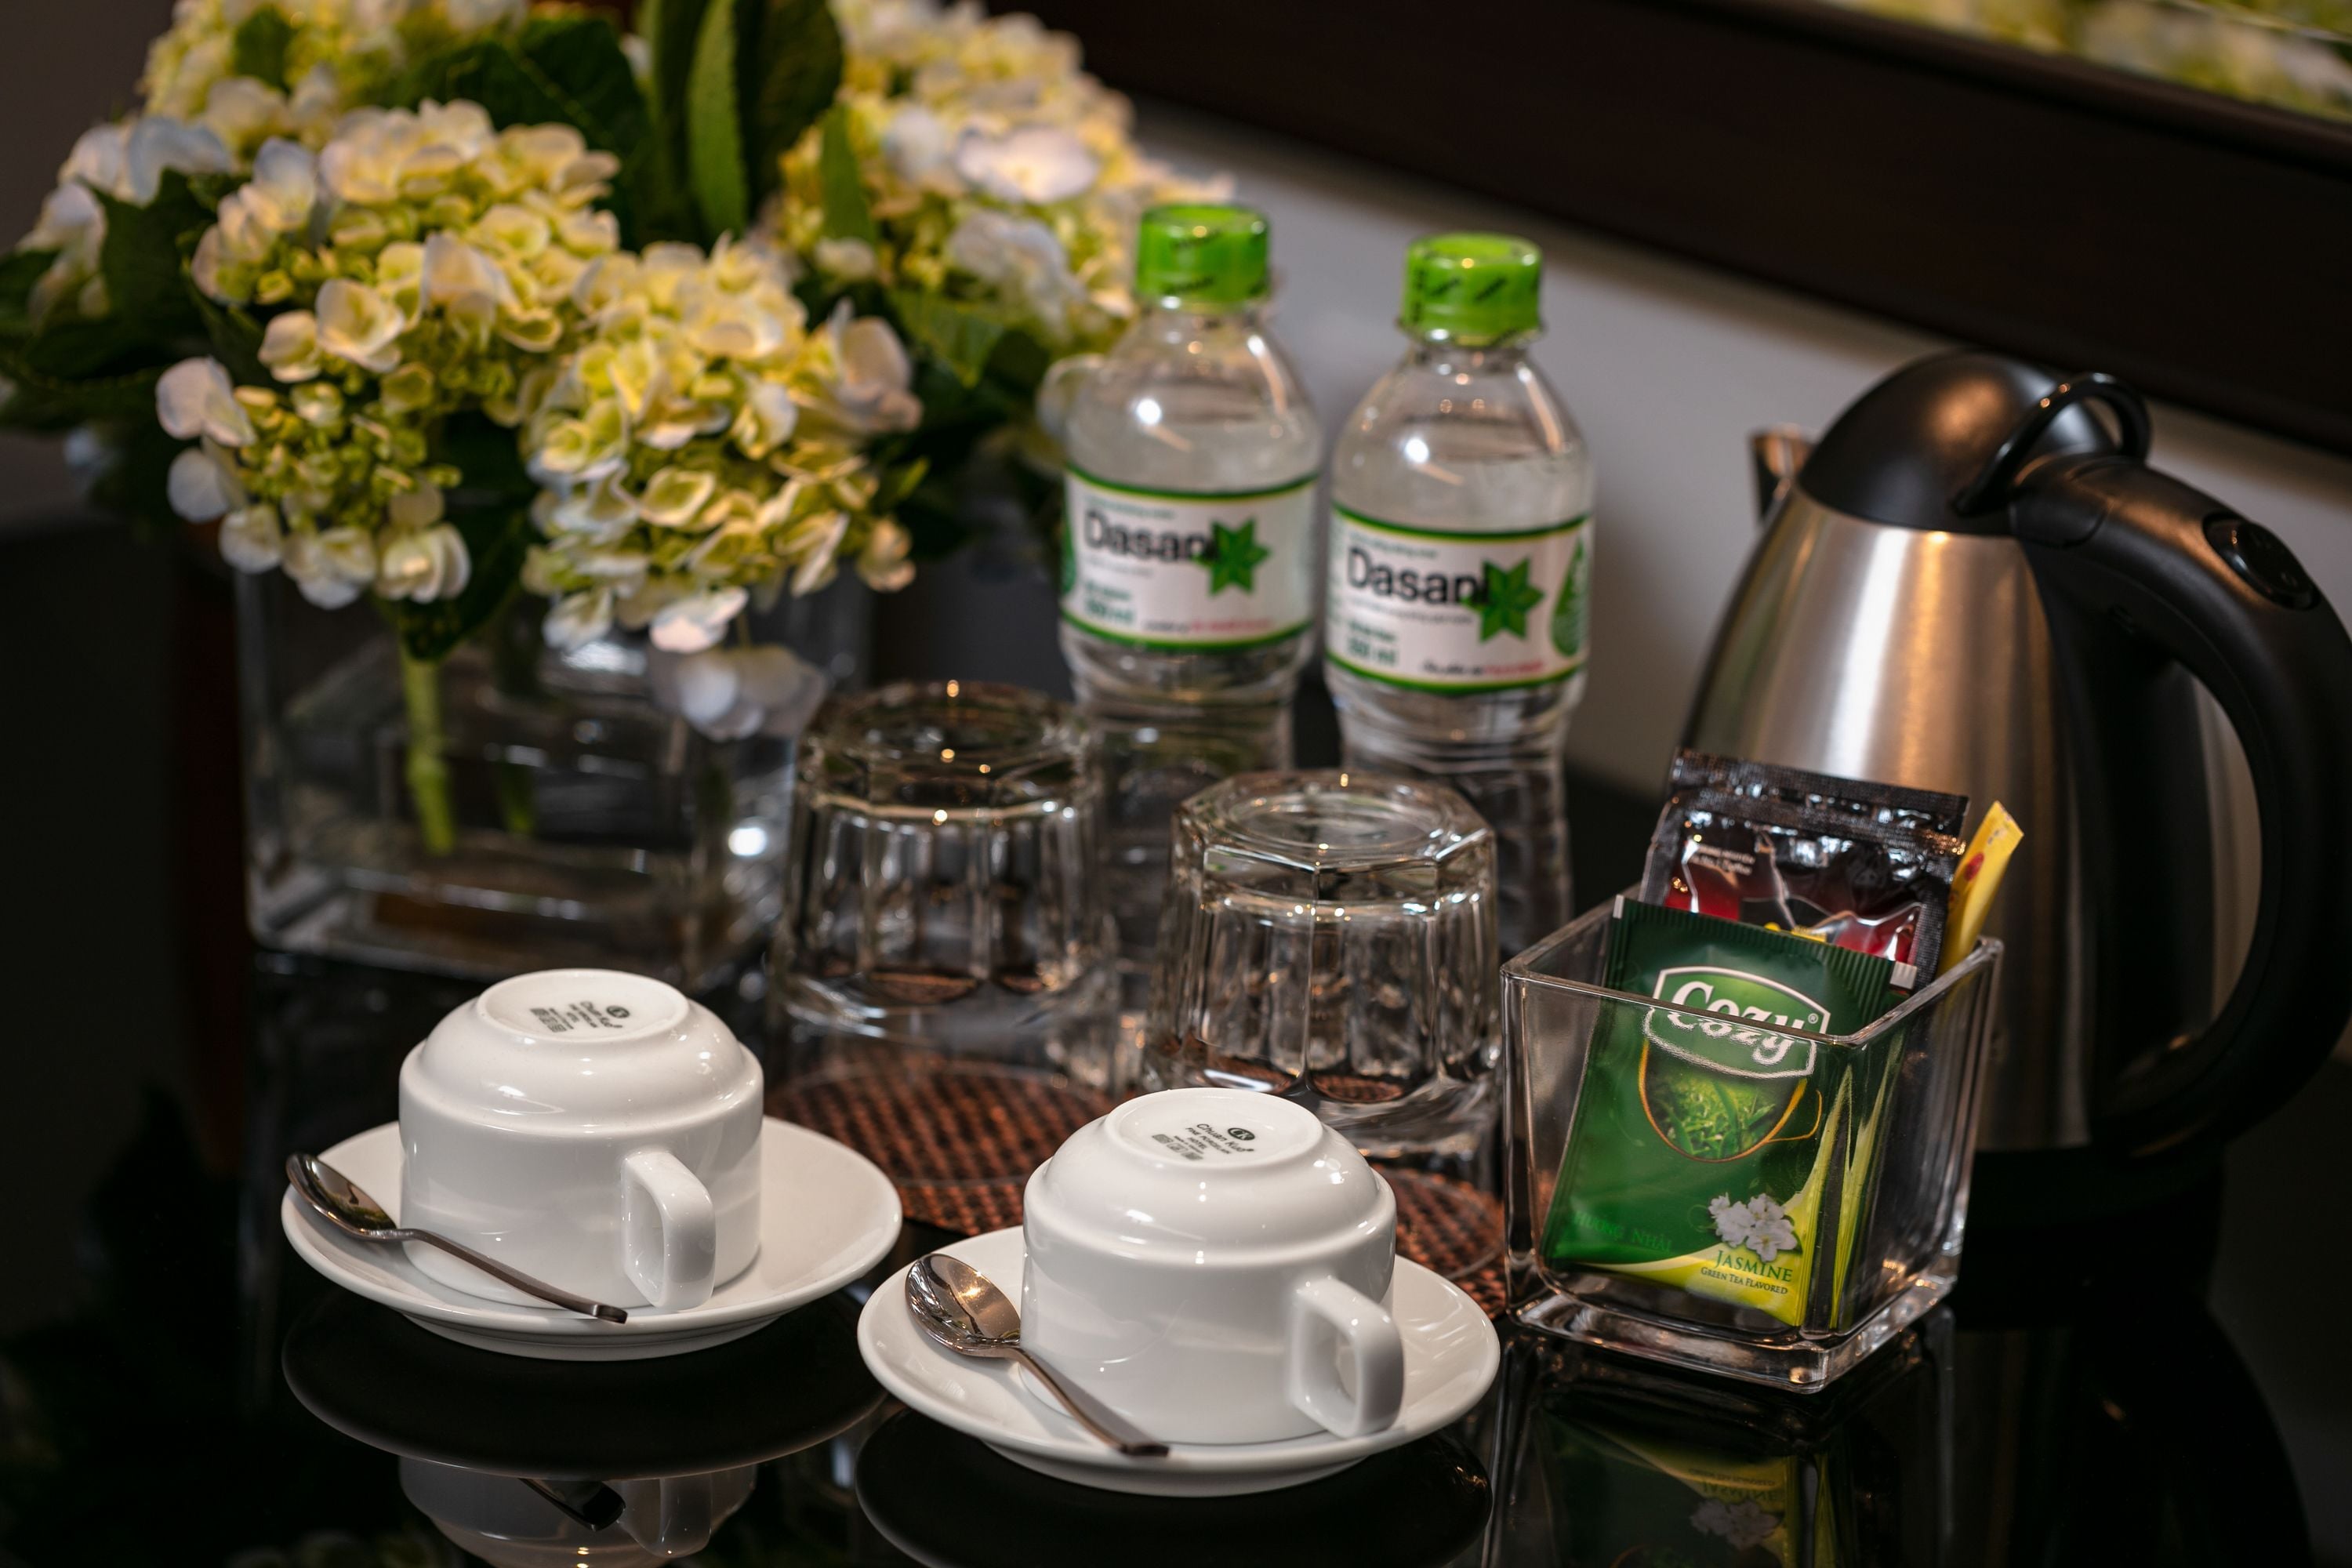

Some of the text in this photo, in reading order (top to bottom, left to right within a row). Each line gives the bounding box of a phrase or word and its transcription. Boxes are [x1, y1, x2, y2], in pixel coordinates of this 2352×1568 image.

[1667, 980, 1806, 1066] Cozy
[1196, 1123, 1228, 1142] Chuan
[1700, 1267, 1788, 1294] GREEN TEA FLAVORED
[1714, 1250, 1794, 1283] JASMINE
